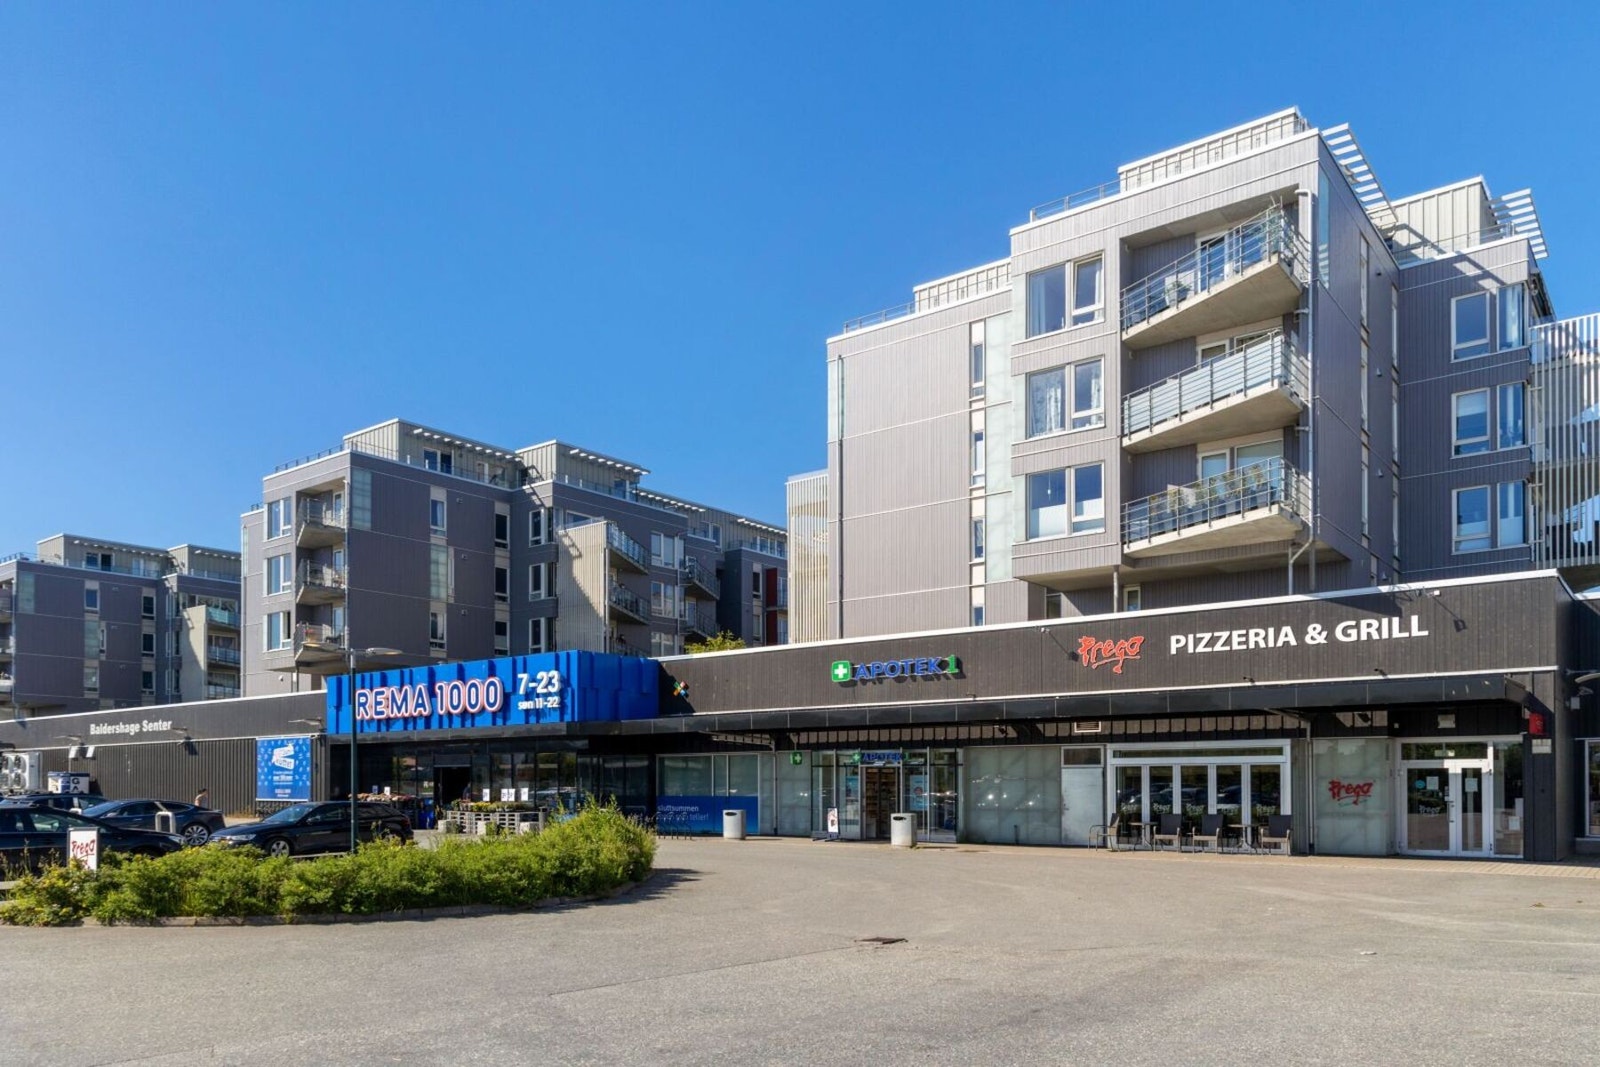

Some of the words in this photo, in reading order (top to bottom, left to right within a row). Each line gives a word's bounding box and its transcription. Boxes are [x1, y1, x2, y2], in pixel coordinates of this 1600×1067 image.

[1170, 626, 1297, 655] PIZZERIA
[1304, 623, 1328, 645] &
[1335, 615, 1429, 643] GRILL
[855, 657, 942, 680] APOTEK
[947, 654, 959, 674] 1
[1078, 635, 1145, 674] Prego
[517, 670, 561, 695] 7-23
[355, 684, 432, 720] REMA
[434, 676, 504, 716] 1000
[535, 696, 561, 709] 11-22
[89, 722, 141, 736] Baldershage
[142, 719, 172, 732] Senter
[1328, 779, 1374, 806] Prego
